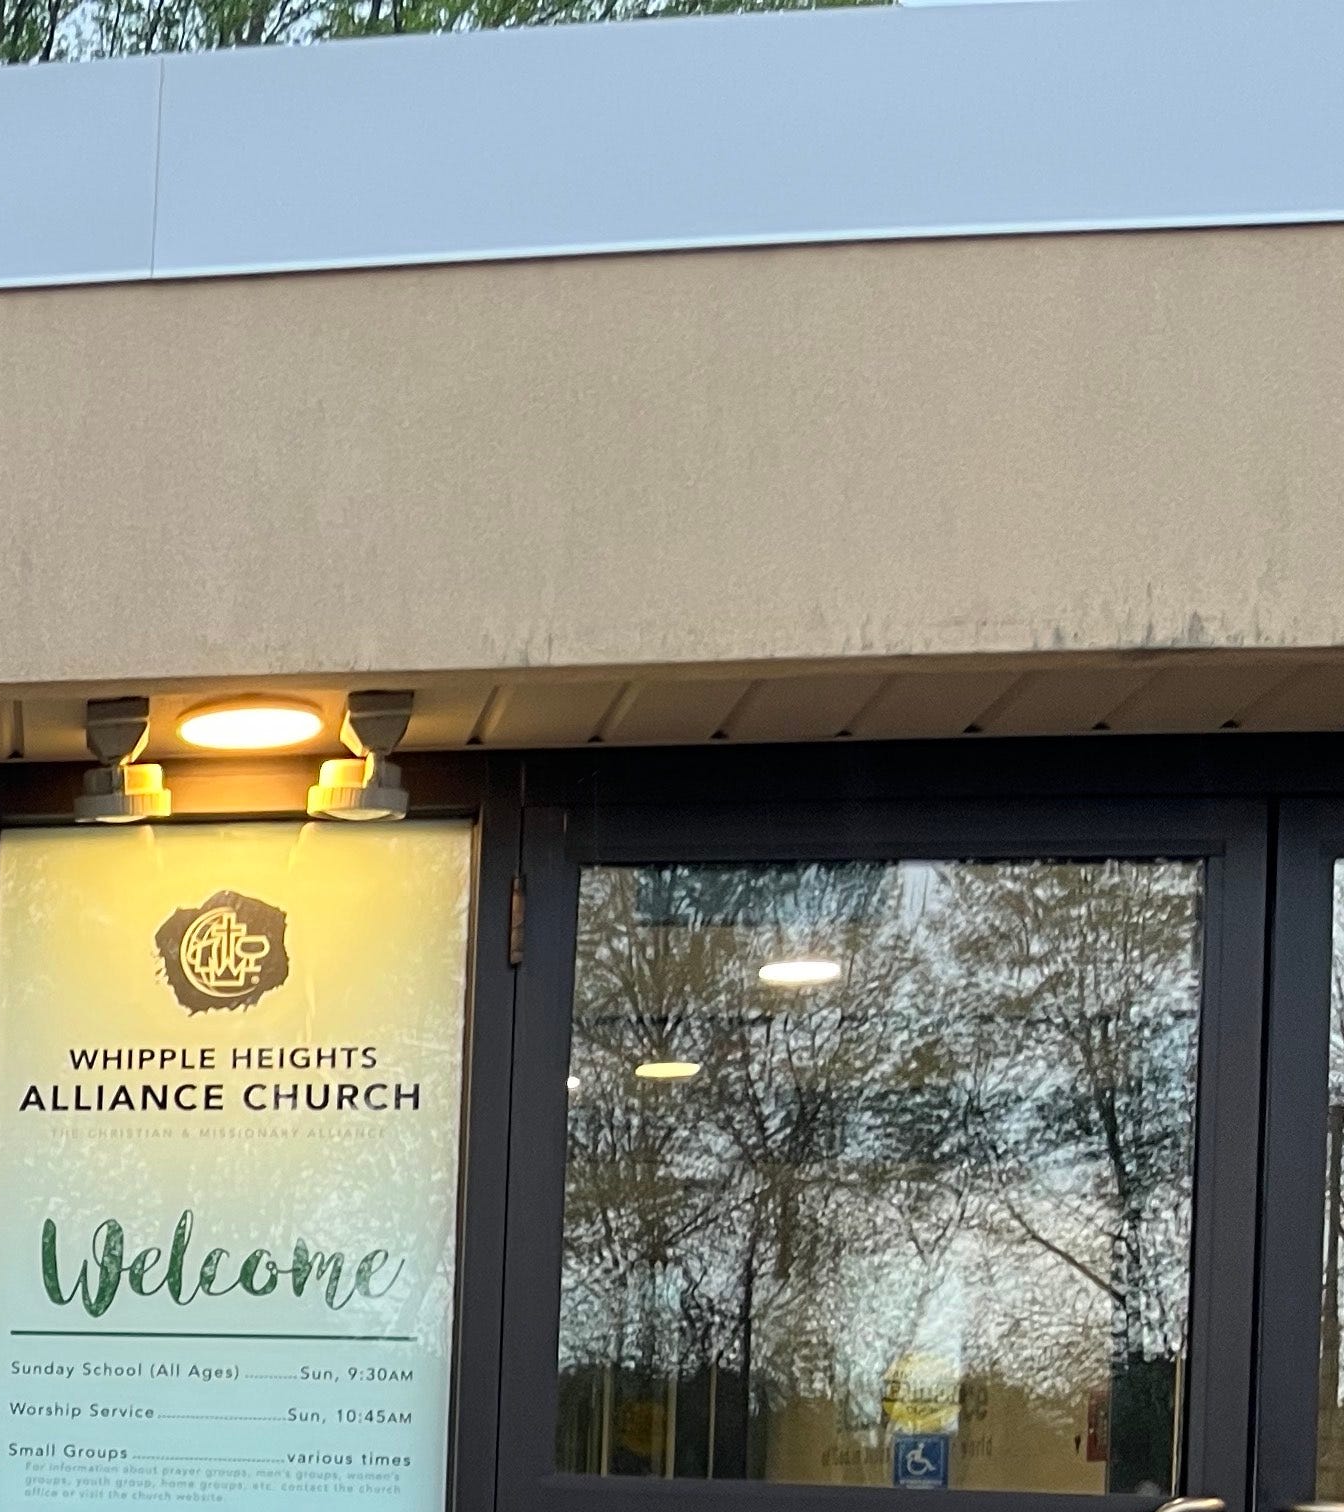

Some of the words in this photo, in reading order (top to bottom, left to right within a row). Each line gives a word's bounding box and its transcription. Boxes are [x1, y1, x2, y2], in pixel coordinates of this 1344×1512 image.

[69, 1047, 216, 1071] WHIPPLE
[231, 1047, 377, 1069] HEIGHTS
[18, 1084, 224, 1112] ALLIANCE
[243, 1083, 421, 1112] CHURCH
[40, 1208, 406, 1319] Welcome
[10, 1360, 75, 1379] Sunday
[81, 1361, 143, 1378] School
[149, 1362, 181, 1379] (All
[187, 1363, 241, 1381] Ages)
[299, 1366, 340, 1383] Sun,
[347, 1367, 414, 1383] 9:30AM
[9, 1402, 82, 1421] Worship
[89, 1404, 155, 1420] Service
[286, 1407, 327, 1425] Sun,
[335, 1408, 413, 1426] 10:45AM
[8, 1443, 56, 1458] Small
[62, 1444, 128, 1463] Groups
[285, 1451, 353, 1467] various
[360, 1451, 412, 1468] times
[25, 1462, 46, 1472] For
[49, 1462, 119, 1474] information
[122, 1464, 159, 1475] about
[161, 1466, 201, 1478] prayer
[346, 1470, 401, 1482] women's
[24, 1487, 58, 1498] office
[62, 1489, 76, 1499] or
[79, 1488, 104, 1499] visit
[108, 1489, 128, 1500] the
[131, 1489, 172, 1501] church
[76, 1476, 111, 1487] youth
[160, 1478, 195, 1489] home
[280, 1482, 330, 1493] contact
[333, 1482, 354, 1493] the
[358, 1482, 401, 1494] church
